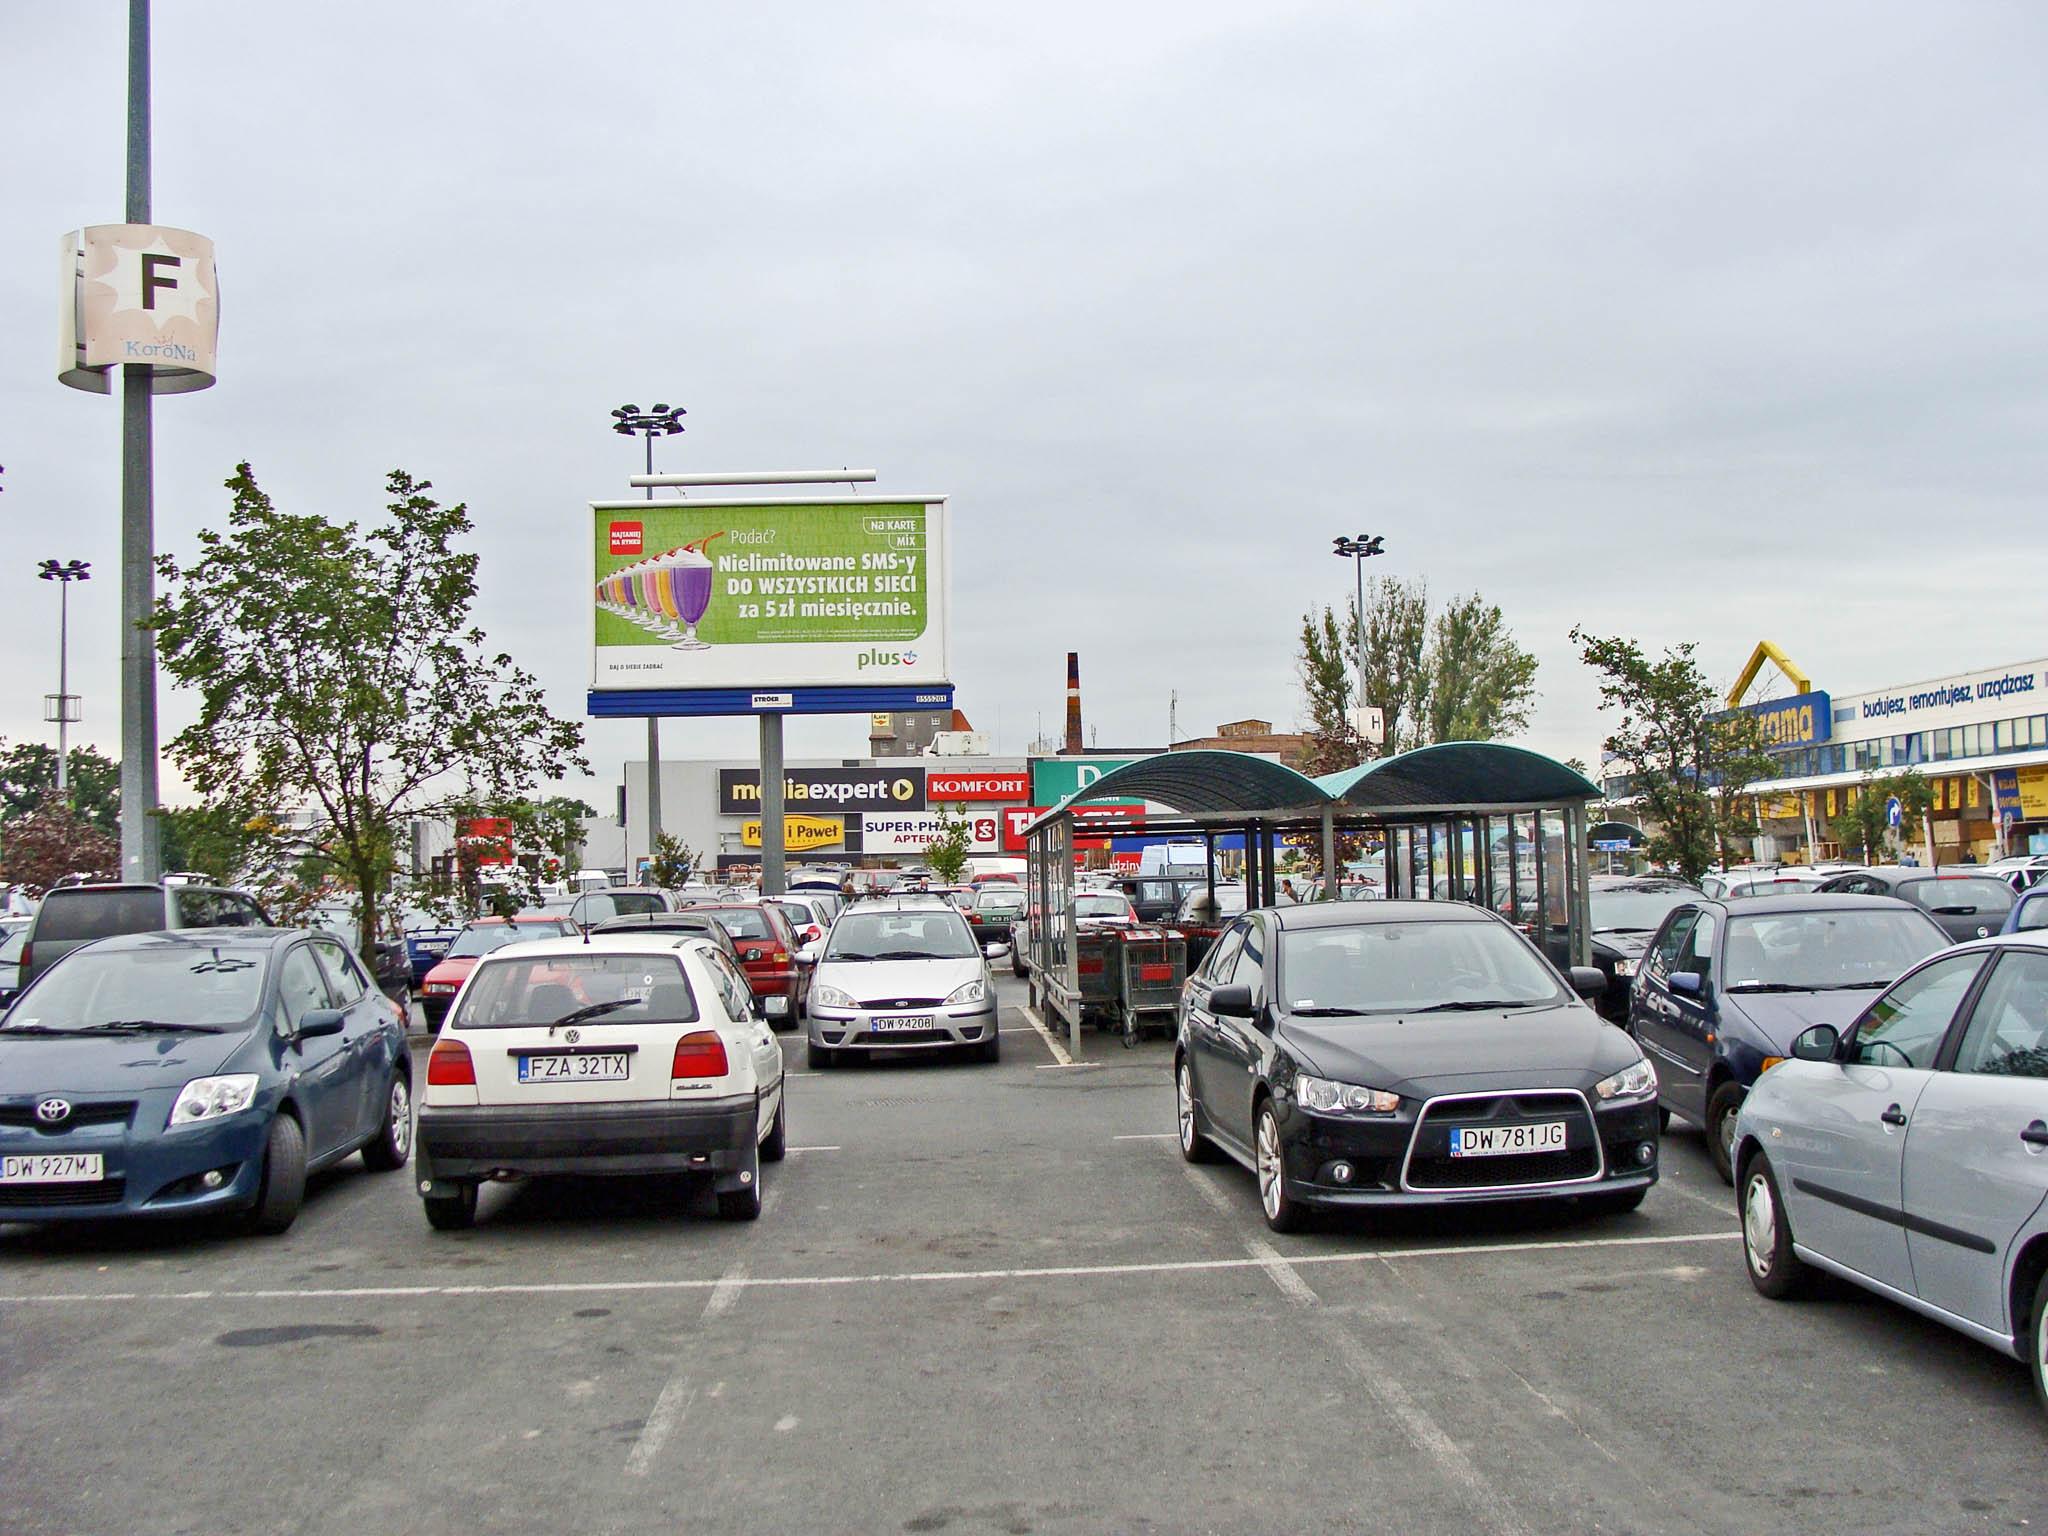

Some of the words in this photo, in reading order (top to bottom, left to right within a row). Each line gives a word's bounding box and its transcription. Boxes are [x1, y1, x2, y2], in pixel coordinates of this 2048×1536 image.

[142, 253, 181, 310] F
[887, 520, 916, 531] KARTĘ
[731, 529, 776, 544] Podać?
[718, 552, 856, 572] Nielimitowane
[861, 552, 917, 574] SMS-y
[727, 578, 752, 595] DO
[759, 576, 868, 594] WSZYSTKICH
[874, 575, 916, 593] SIECI
[739, 604, 759, 618] za
[766, 601, 777, 617] 5
[779, 598, 795, 617] zł
[801, 598, 916, 620] miesięcznie.
[858, 648, 900, 670] plus
[1862, 696, 1907, 718] budujesz,
[1909, 684, 1974, 711] remontujesz,
[1976, 673, 2035, 701] urządzasz
[932, 780, 1025, 793] KOMFORT
[788, 825, 793, 838] i
[797, 824, 839, 838] Paweł
[893, 834, 945, 844] APTEKA
[878, 1019, 895, 1030] DW
[897, 1018, 931, 1029] 94208
[531, 1057, 571, 1077] FZA
[578, 1056, 624, 1075] 32TX
[1464, 1129, 1493, 1150] DW
[1502, 1125, 1562, 1148] 781JG
[6, 1158, 34, 1177] DW
[41, 1156, 98, 1177] 927MJ
